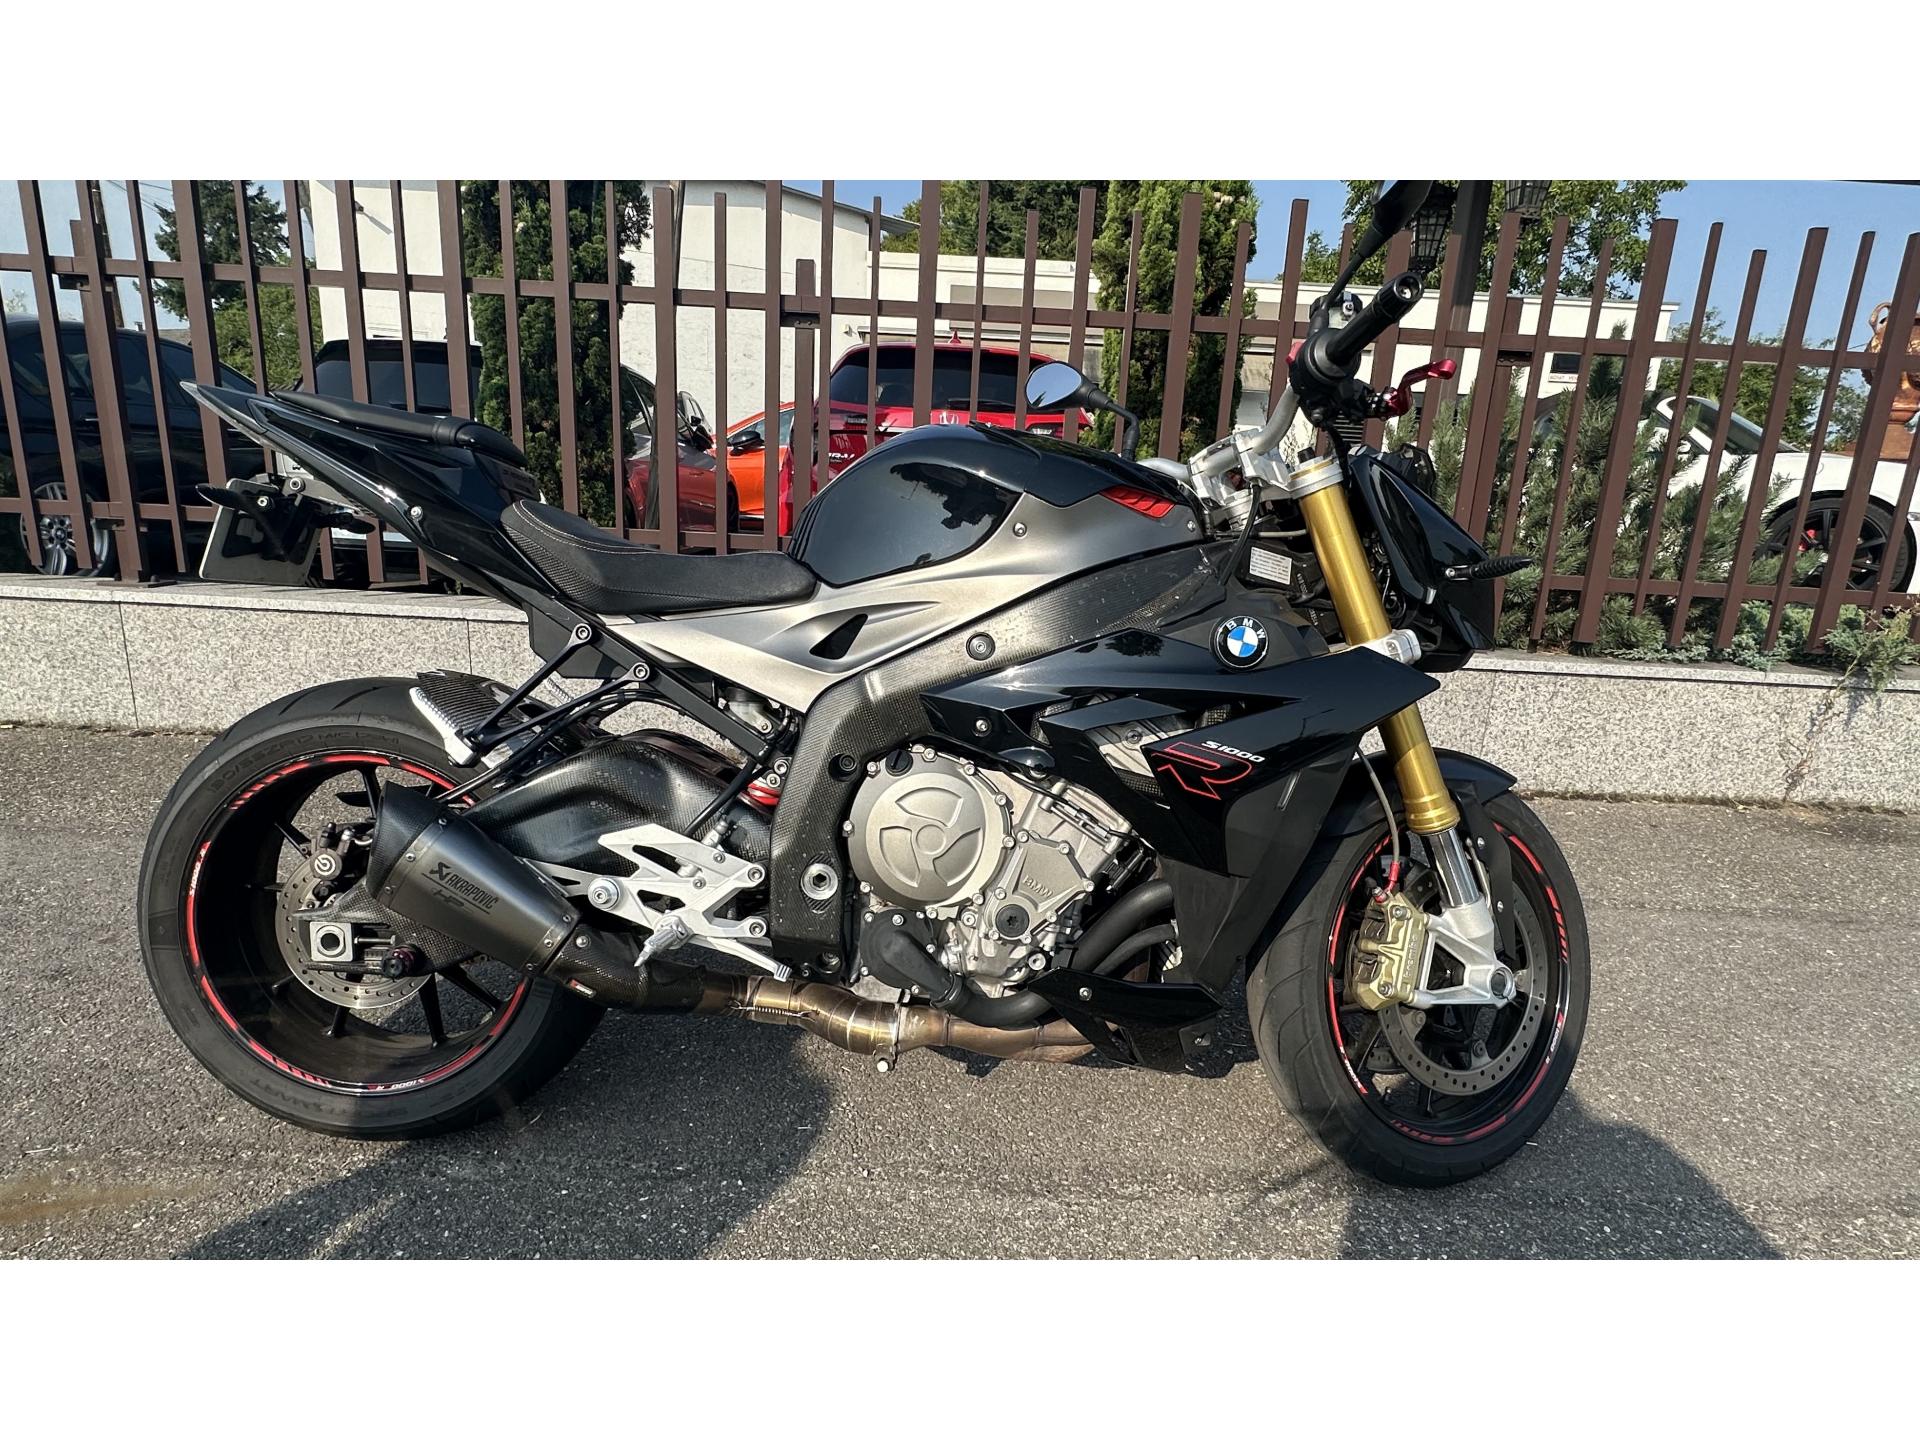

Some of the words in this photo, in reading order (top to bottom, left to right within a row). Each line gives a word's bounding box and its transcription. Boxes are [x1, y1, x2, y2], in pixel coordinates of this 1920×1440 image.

[1225, 617, 1266, 639] BMW
[1201, 740, 1266, 763] S1000
[1022, 874, 1054, 898] BMW
